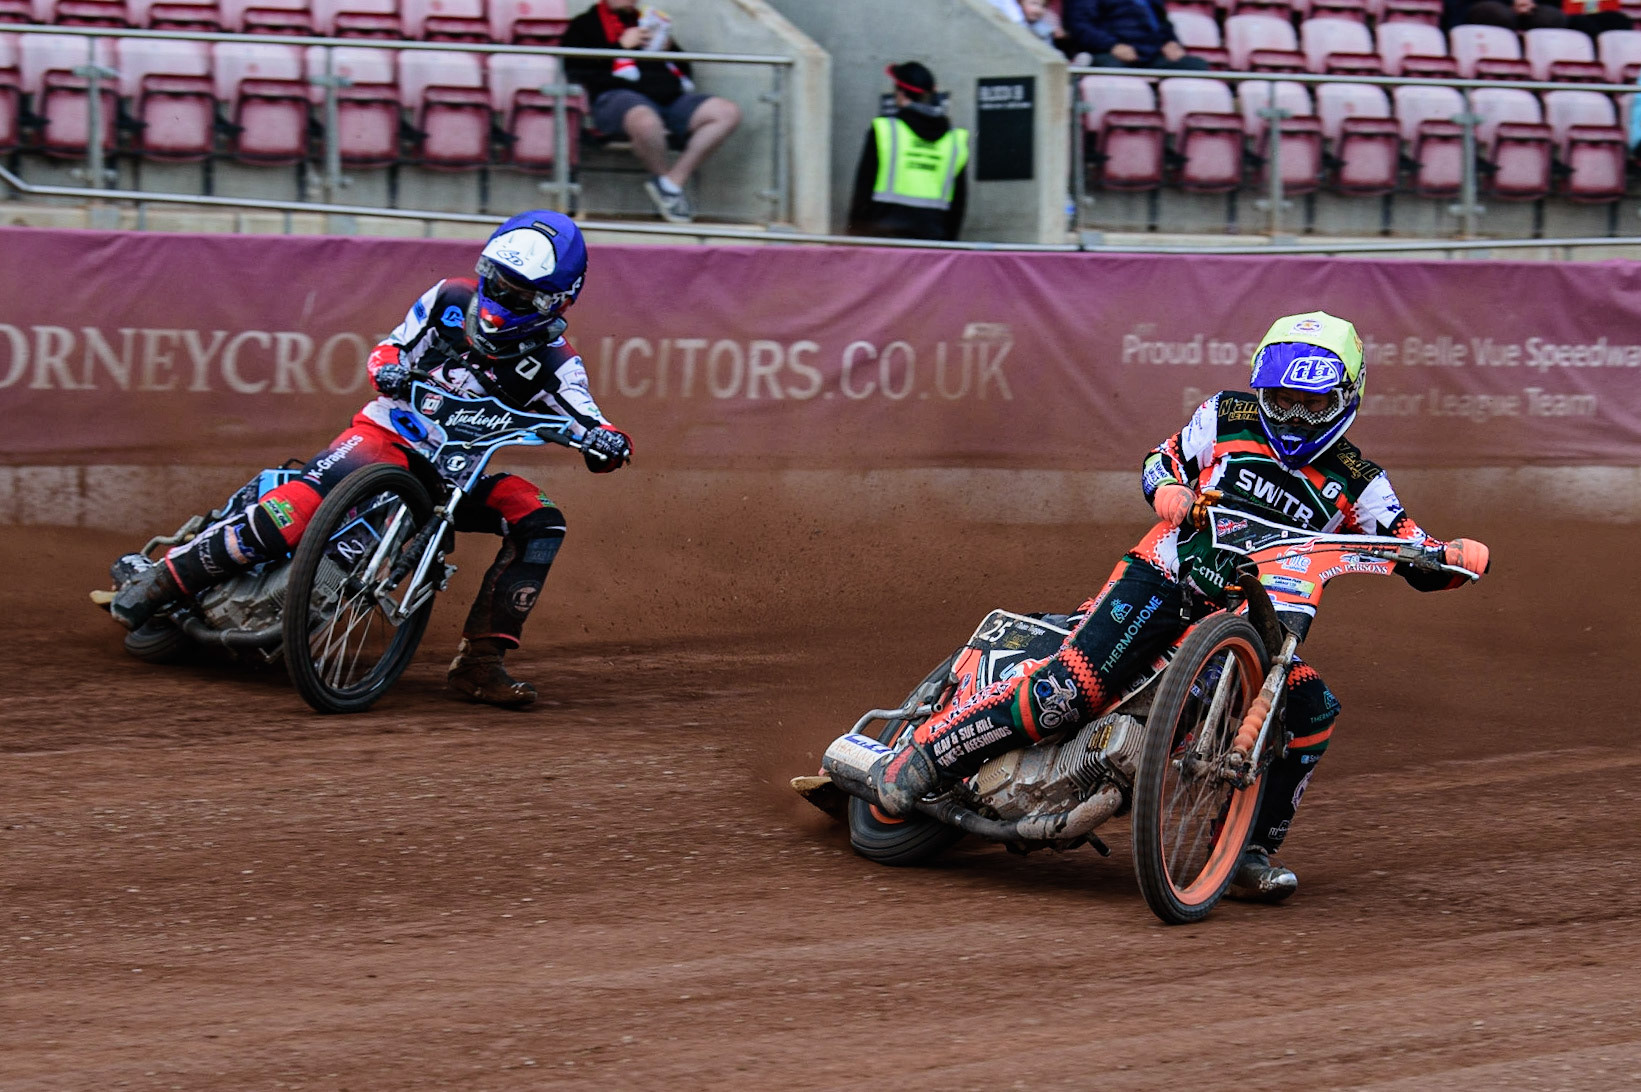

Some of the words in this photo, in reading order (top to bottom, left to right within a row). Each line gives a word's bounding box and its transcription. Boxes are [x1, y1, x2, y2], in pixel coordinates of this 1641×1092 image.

[1122, 333, 1203, 364] Proud
[1207, 339, 1238, 365] to
[1403, 336, 1467, 366] Belle
[1470, 337, 1521, 366] Vue
[1428, 387, 1520, 422] League
[1523, 387, 1598, 416] Team
[1321, 481, 1342, 499] 6
[1319, 565, 1343, 580] JOHN
[1344, 564, 1388, 574] PARSONS
[979, 619, 1014, 643] 25
[1100, 595, 1163, 673] THERMOHOME
[958, 724, 975, 741] SUE
